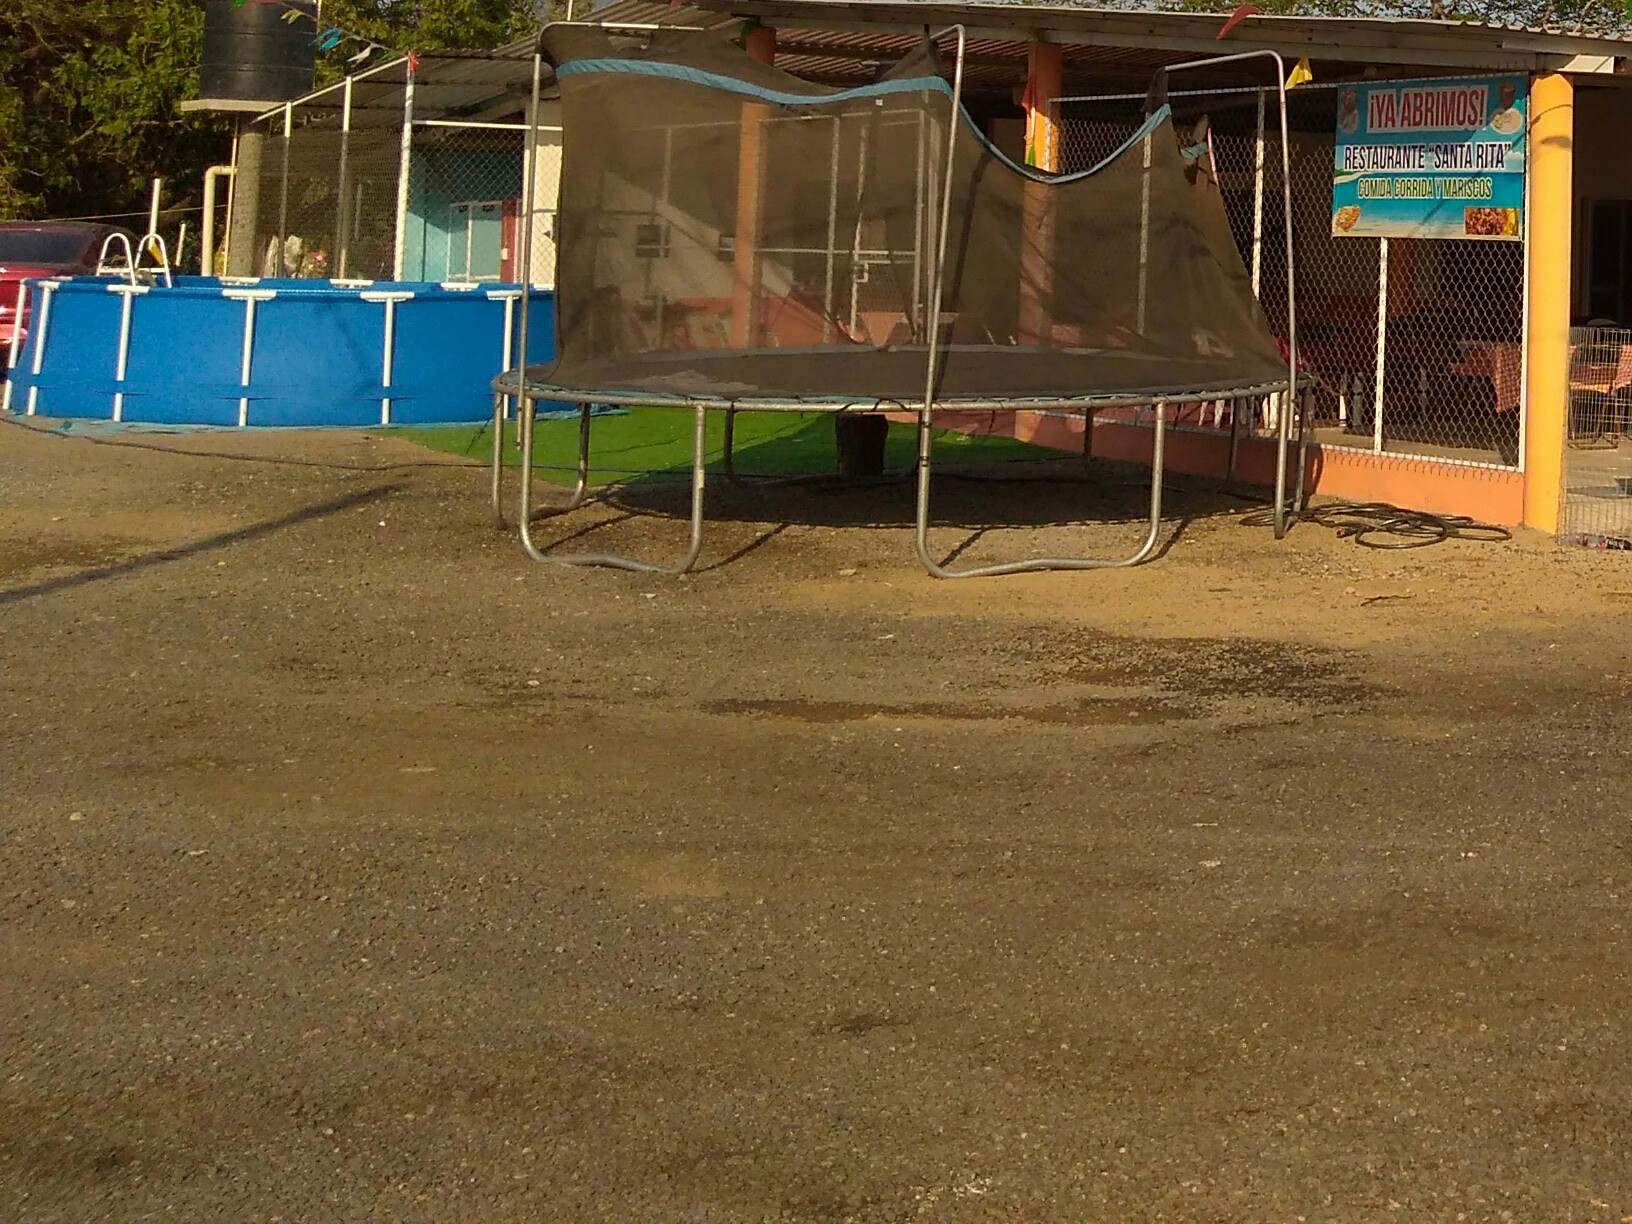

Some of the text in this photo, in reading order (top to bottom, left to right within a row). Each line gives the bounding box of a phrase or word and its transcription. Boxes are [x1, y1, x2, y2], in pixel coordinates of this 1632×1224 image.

[1400, 89, 1486, 128] ABRIMOS!
[1344, 144, 1425, 170] RESTAURANTE
[1358, 177, 1493, 199] COMIDA CORRIDA Y MARISCOS
